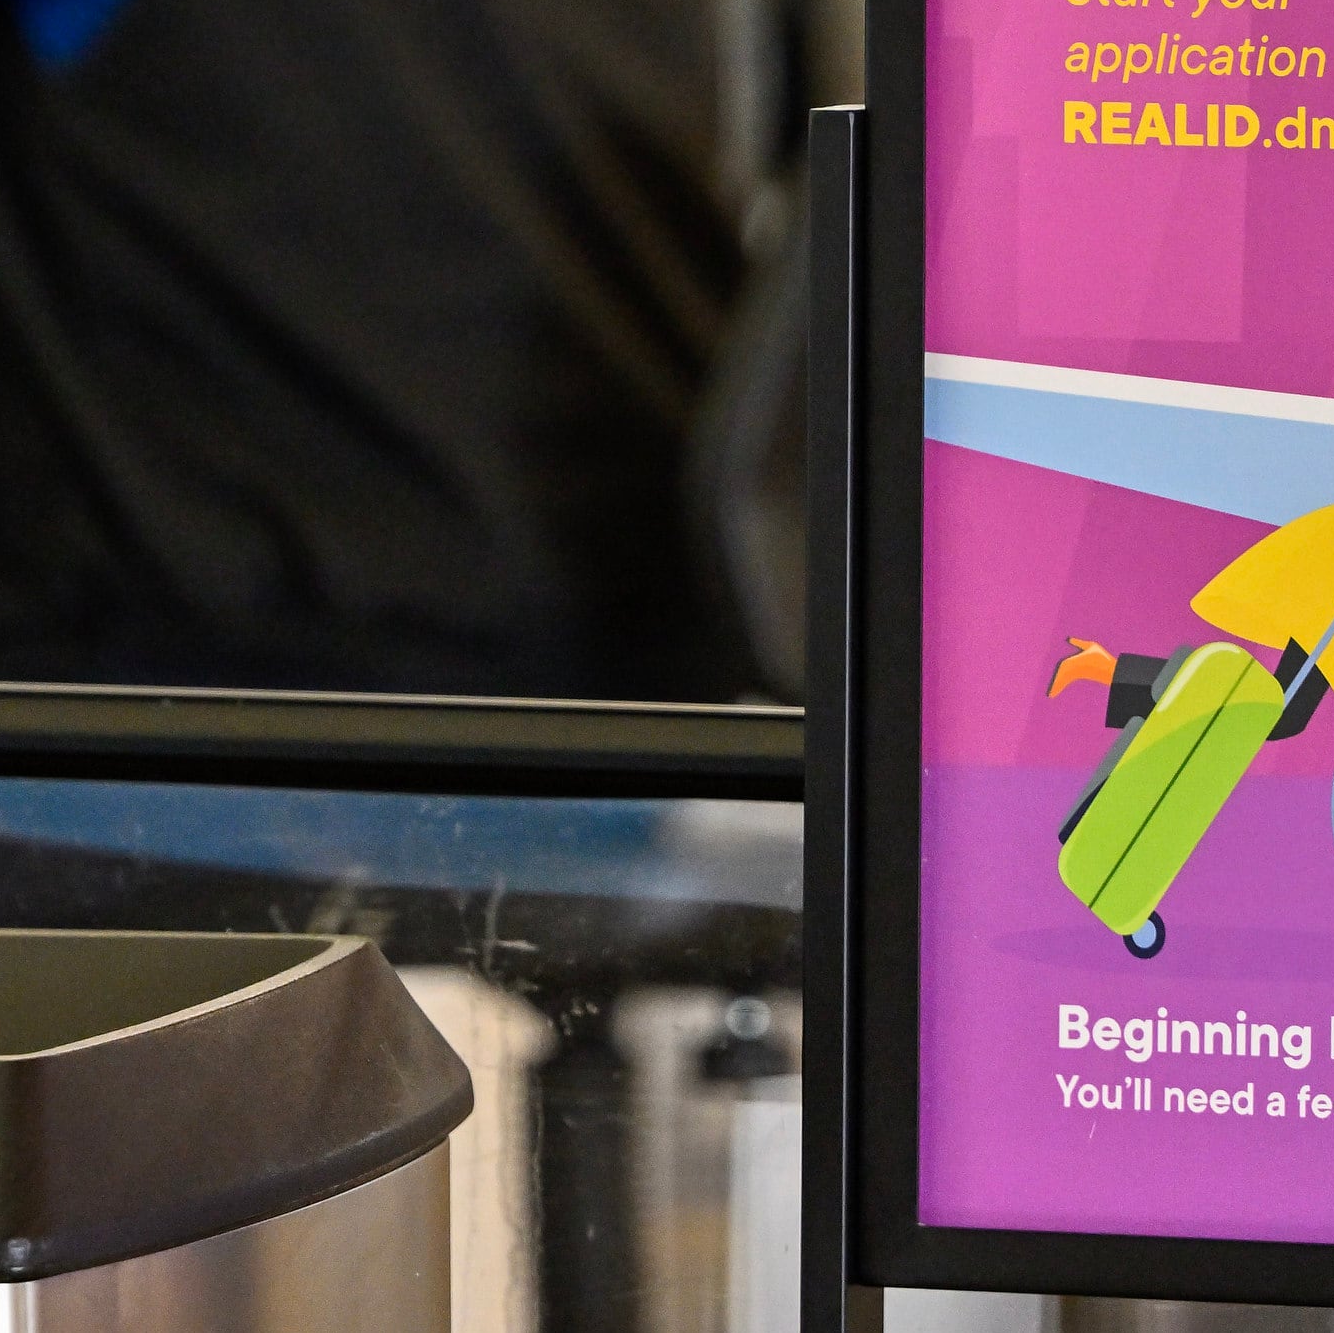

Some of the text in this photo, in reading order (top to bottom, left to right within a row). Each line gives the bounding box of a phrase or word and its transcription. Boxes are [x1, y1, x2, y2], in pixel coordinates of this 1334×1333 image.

[1064, 33, 1327, 83] application
[1058, 1004, 1312, 1070] Beginning
[1055, 1074, 1151, 1112] You’ll
[1163, 1082, 1255, 1116] need
[1266, 1091, 1286, 1118] a
